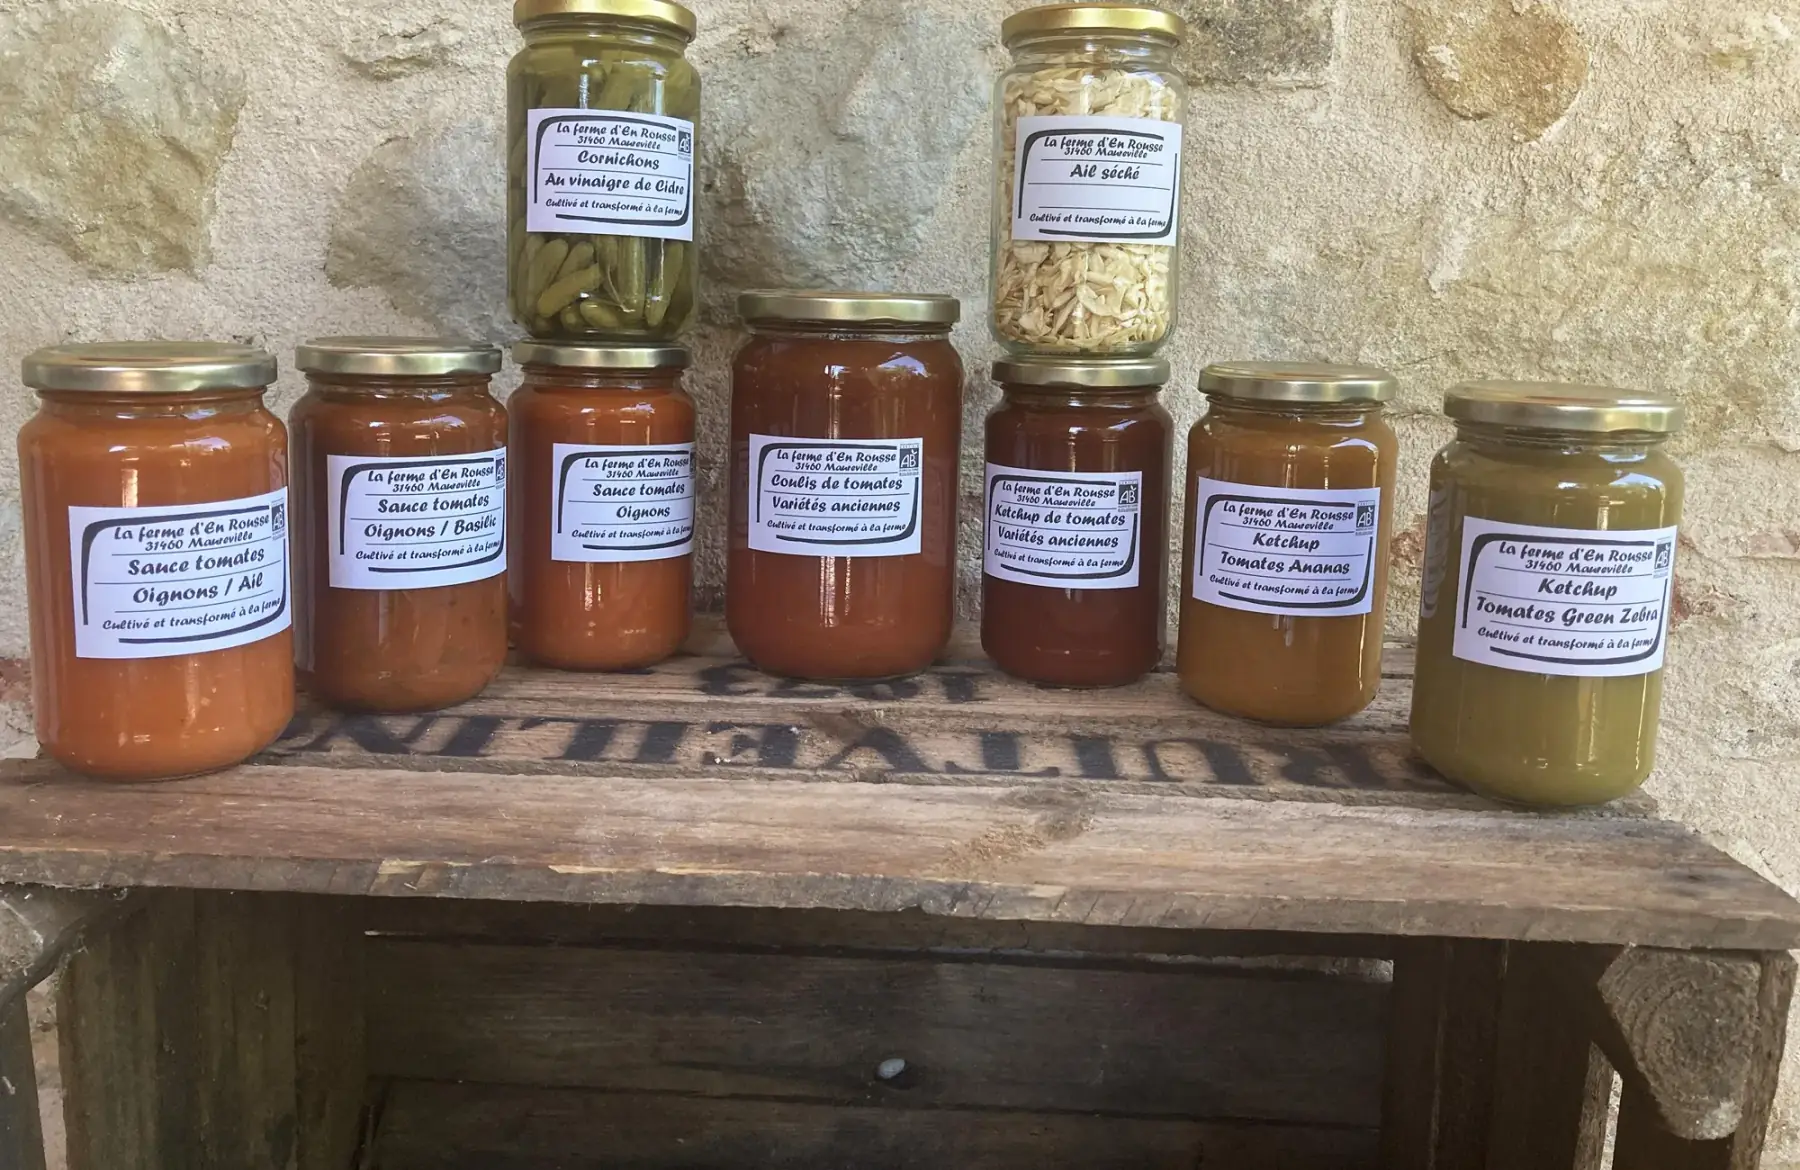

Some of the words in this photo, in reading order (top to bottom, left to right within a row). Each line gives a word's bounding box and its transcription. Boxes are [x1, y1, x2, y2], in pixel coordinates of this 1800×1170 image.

[557, 122, 570, 133] La
[573, 123, 606, 136] ferme
[610, 124, 637, 137] d'En
[641, 127, 676, 142] Rousse
[1044, 136, 1057, 147] La
[1061, 136, 1093, 150] ferme
[1098, 137, 1124, 149] d'En
[1128, 139, 1163, 152] Rousse
[578, 150, 660, 170] Cornichons
[1070, 164, 1096, 177] Ail
[1101, 165, 1140, 180] séché
[545, 173, 565, 186] Au
[569, 174, 629, 191] vinaigre
[635, 177, 651, 191] de
[655, 180, 684, 195] Cidre
[546, 199, 577, 207] Cultivé
[580, 199, 588, 208] et
[592, 201, 643, 212] transformé
[646, 203, 651, 212] à
[653, 203, 663, 213] la
[1030, 213, 1061, 222] Cultivé
[1075, 216, 1126, 225] transformé
[1128, 217, 1134, 225] à
[1137, 216, 1146, 226] la
[585, 459, 599, 468] La
[602, 459, 634, 470] ferme
[637, 459, 661, 468] d'En
[777, 450, 789, 460] La
[792, 452, 822, 462] ferme
[826, 452, 852, 461] d'En
[856, 452, 896, 462] Rousse
[368, 471, 383, 482] La
[388, 471, 425, 484] ferme
[429, 469, 458, 480] d'En
[461, 466, 493, 478] Rousse
[795, 462, 821, 470] 31460
[824, 463, 877, 471] Maureville
[593, 484, 636, 496] Sauce
[640, 482, 685, 495] tomates
[771, 474, 817, 490] Coulis
[822, 476, 839, 489] de
[844, 478, 903, 491] tomates
[1003, 481, 1012, 491] La
[1014, 482, 1040, 495] ferme
[1044, 485, 1070, 497] d'En
[1074, 487, 1115, 498] Rousse
[378, 499, 428, 513] Sauce
[433, 494, 489, 510] tomates
[772, 496, 827, 512] Variétés
[831, 499, 901, 512] anciennes
[1223, 501, 1236, 513] La
[1239, 503, 1273, 516] ferme
[1278, 507, 1307, 519] d'En
[1310, 508, 1354, 520] Rousse
[616, 506, 670, 521] Oignons
[995, 504, 1040, 524] Ketchup
[1044, 511, 1061, 524] de
[1066, 514, 1125, 526] tomates
[114, 527, 133, 540] La
[138, 526, 185, 542] ferme
[190, 523, 224, 536] d'En
[229, 515, 269, 531] Rousse
[364, 523, 435, 540] Oignons
[440, 521, 448, 536] /
[454, 515, 496, 535] Basilic
[572, 530, 605, 538] Cultivé
[619, 528, 664, 539] transformé
[666, 527, 671, 535] à
[767, 520, 796, 530] Cultivé
[798, 522, 806, 530] et
[809, 524, 859, 533] transformé
[870, 524, 880, 532] la
[883, 523, 906, 533] ferme
[999, 526, 1044, 545] Variétés
[1048, 535, 1119, 548] anciennes
[1253, 533, 1320, 552] Ketchup
[356, 551, 393, 560] Cultivé
[397, 551, 407, 559] et
[410, 544, 465, 559] transformé
[467, 543, 473, 553] à
[474, 543, 484, 552] la
[994, 549, 1017, 560] Cultivé
[1018, 554, 1026, 562] et
[1028, 555, 1075, 567] transformé
[1078, 558, 1084, 566] à
[1087, 558, 1098, 566] la
[1100, 559, 1124, 568] ferme
[1499, 542, 1516, 555] La
[1520, 544, 1564, 559] ferme
[1570, 547, 1604, 561] d'En
[1608, 549, 1652, 562] Rousse
[128, 559, 189, 575] Sauce
[196, 548, 264, 570] tomates
[1221, 551, 1284, 572] Tomates
[1288, 560, 1350, 574] Ananas
[133, 585, 218, 606] Oignons
[225, 578, 233, 596] /
[238, 572, 263, 592] Ail
[1210, 574, 1240, 588] Cultivé
[1242, 581, 1251, 590] et
[1254, 582, 1310, 595] transformé
[1313, 586, 1319, 595] à
[1321, 587, 1334, 595] la
[1336, 587, 1359, 597] ferme
[1538, 578, 1618, 600] Ketchup
[102, 619, 149, 630] Cultivé
[154, 618, 165, 628] et
[170, 609, 236, 627] transformé
[239, 606, 246, 616] à
[248, 605, 260, 615] la
[1476, 596, 1555, 621] Tomates
[1562, 608, 1614, 627] Green
[1620, 606, 1658, 623] Zebra
[1478, 627, 1519, 642] Cultivé
[1522, 635, 1533, 644] et
[1538, 636, 1604, 650] transformé
[1609, 639, 1615, 648] à
[1617, 638, 1630, 648] la
